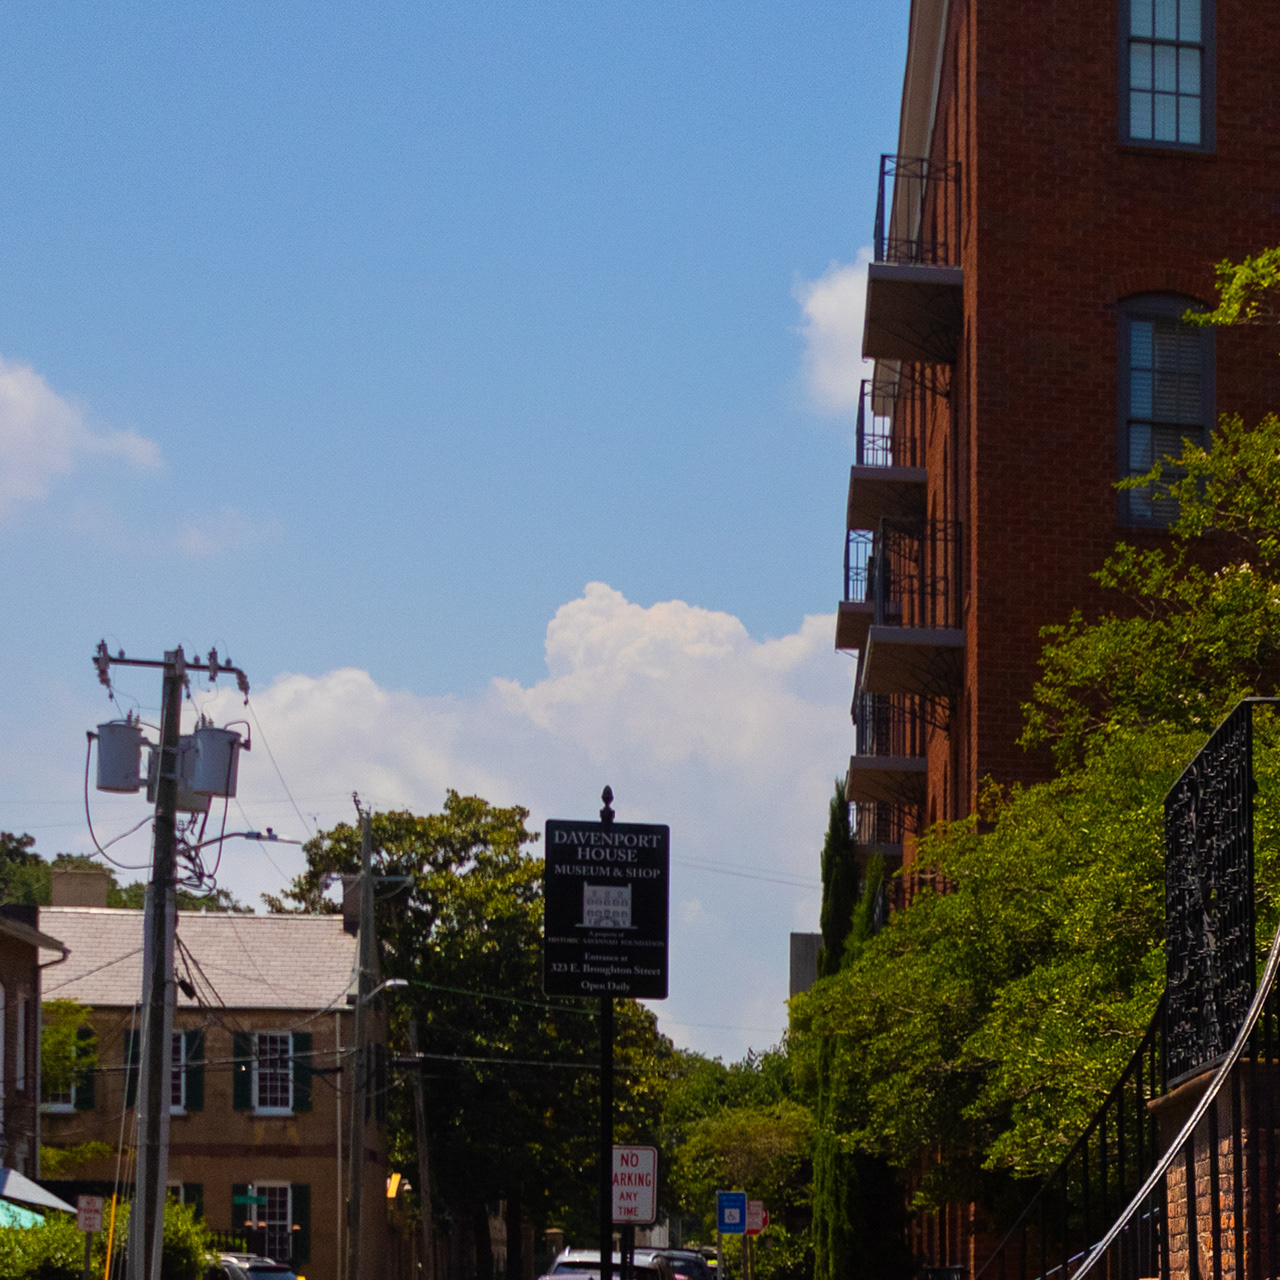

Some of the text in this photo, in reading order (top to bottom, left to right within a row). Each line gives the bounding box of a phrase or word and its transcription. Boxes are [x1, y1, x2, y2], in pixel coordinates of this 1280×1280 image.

[554, 830, 661, 848] DAVENPORT
[577, 847, 638, 862] HOUSE
[554, 864, 660, 879] MUSEUM & SHOP
[584, 953, 619, 962] Entrance
[551, 963, 661, 976] 323 E. Broughton Street
[581, 981, 630, 992] Open Daily
[620, 1153, 639, 1167] NO
[613, 1173, 651, 1187] ARKING
[619, 1191, 638, 1201] ANY
[618, 1206, 638, 1216] TIME
